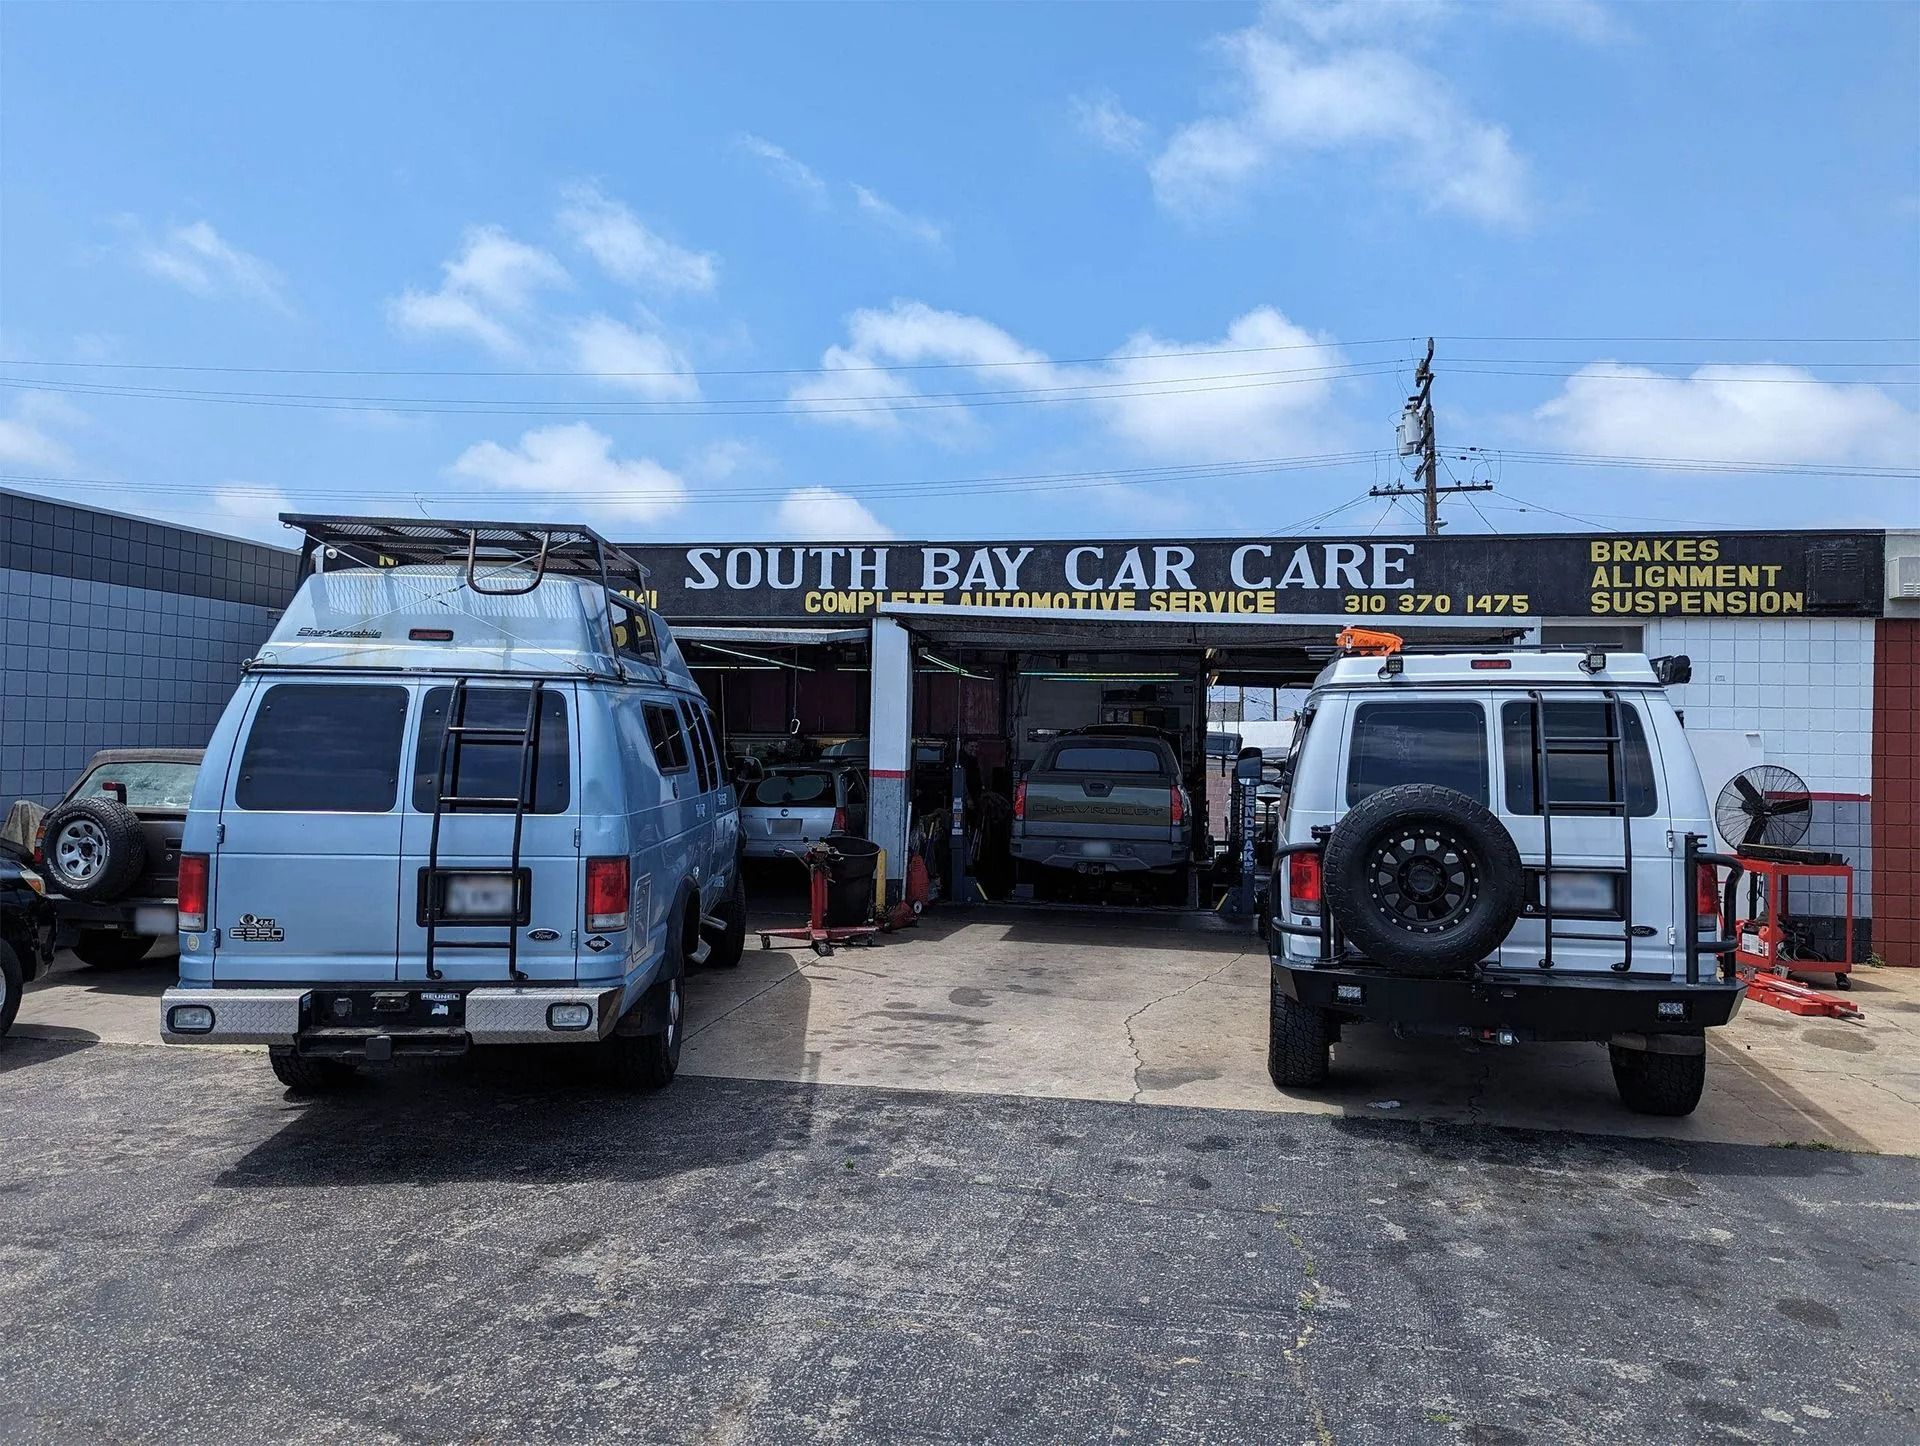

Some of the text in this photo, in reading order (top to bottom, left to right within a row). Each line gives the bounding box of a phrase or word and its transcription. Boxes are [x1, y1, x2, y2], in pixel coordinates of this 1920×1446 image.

[1590, 539, 1720, 562] BRAKES
[684, 543, 1415, 591] SOUTH BAY CAR CARE
[1591, 565, 1783, 588] ALIGNMENT
[959, 591, 1137, 612] AUTOMOTIVE
[1149, 590, 1276, 613] SERVICE
[1344, 594, 1530, 614] 310 370 1475
[1591, 591, 1805, 614] SUSPENSION
[296, 627, 382, 639] Sportsmobile
[1032, 803, 1165, 816] CHEVROLET
[1243, 786, 1256, 861] BENDPAK
[534, 932, 554, 940] Ford
